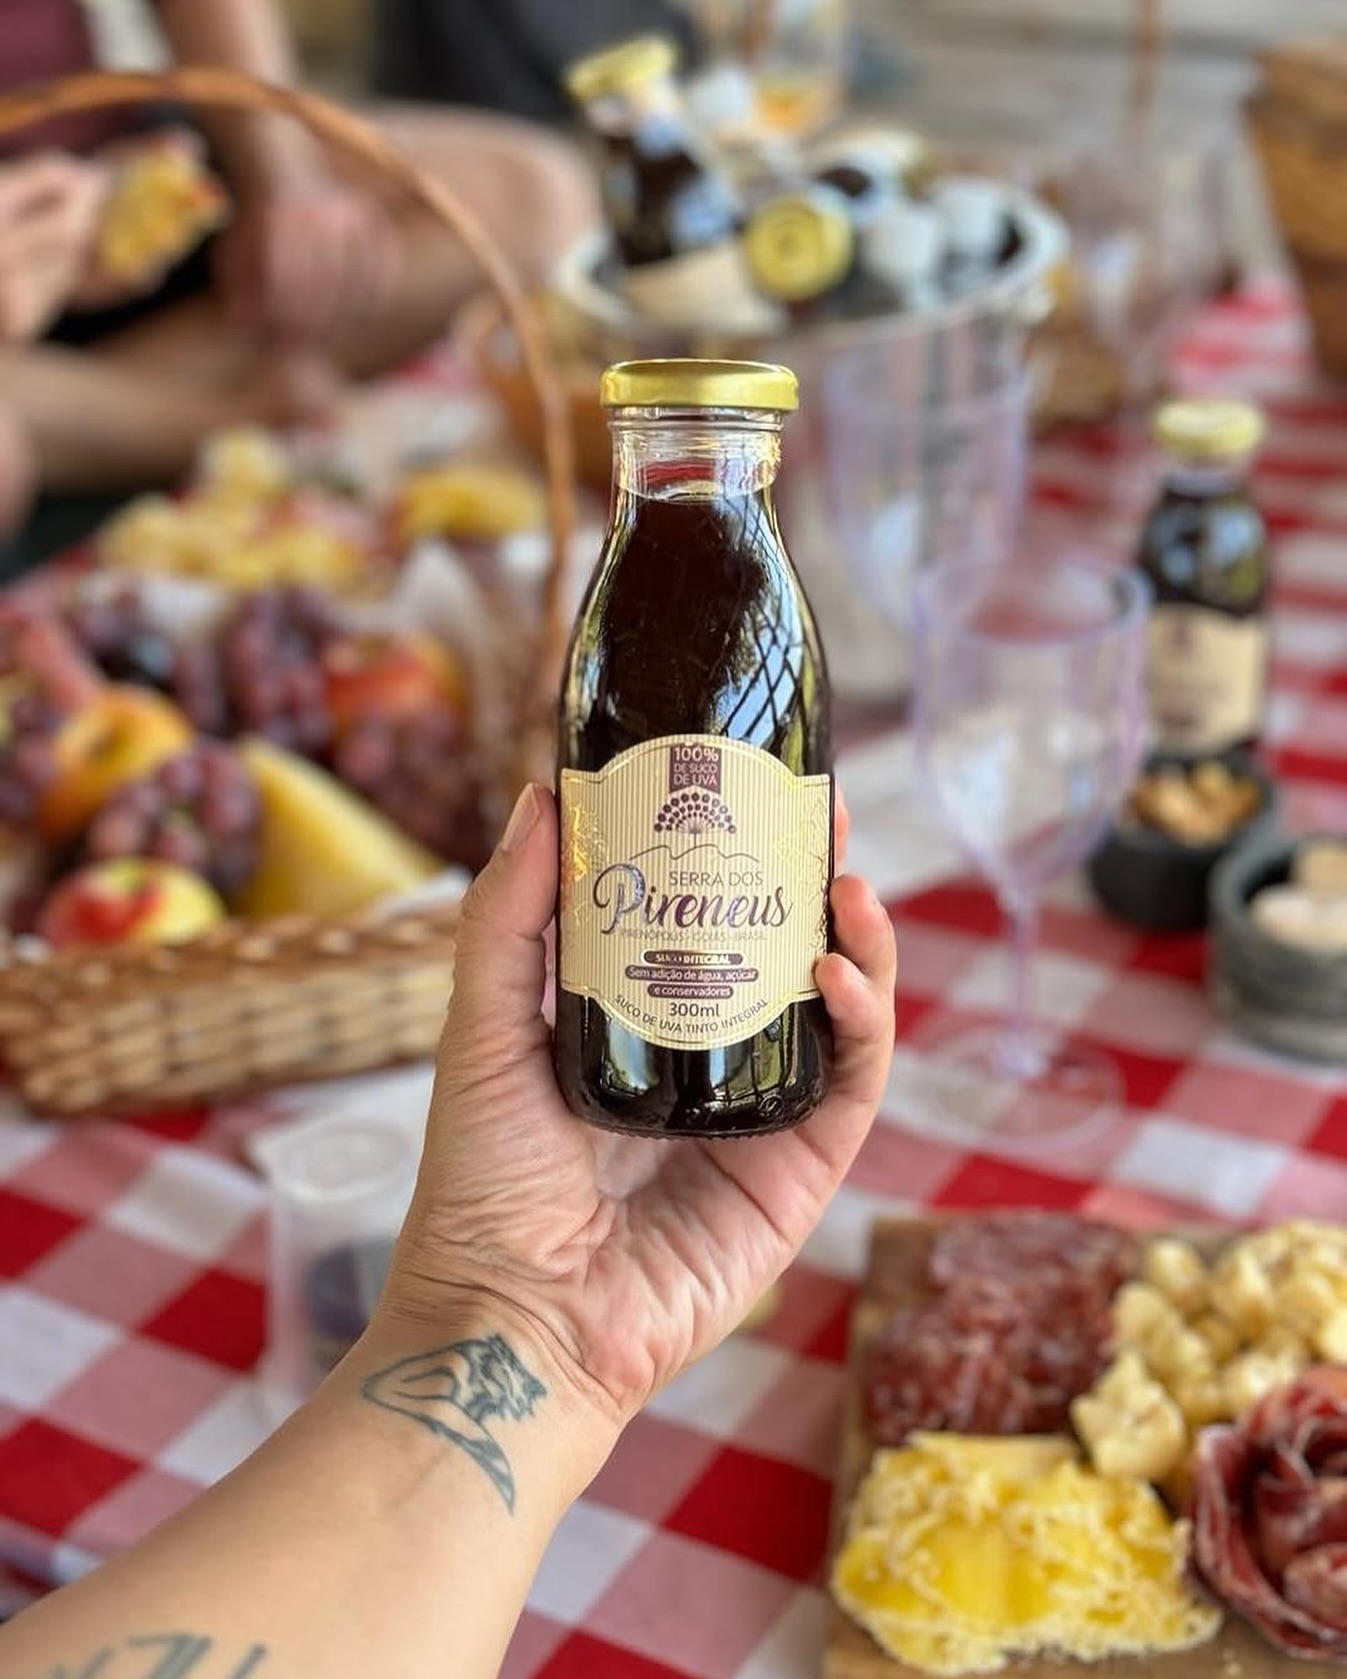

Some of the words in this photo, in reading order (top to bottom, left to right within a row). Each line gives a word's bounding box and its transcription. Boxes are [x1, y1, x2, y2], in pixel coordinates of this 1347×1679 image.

[673, 747, 719, 762] 100%
[673, 763, 688, 773] DE
[689, 763, 718, 774] SUCO
[673, 774, 690, 785] DE
[692, 774, 718, 785] UVA
[669, 871, 724, 887] SERRA
[729, 872, 764, 887] DOS
[593, 863, 794, 934] Pireneus
[629, 967, 650, 978] Sem
[651, 968, 683, 982] adição
[684, 968, 697, 979] de
[725, 969, 757, 983] açúcar
[654, 986, 661, 995] e
[662, 985, 731, 997] conservadores
[615, 994, 641, 1018] SUCO
[642, 1012, 658, 1027] DE
[659, 1019, 682, 1034] UVA
[686, 1022, 719, 1034] TINTO
[721, 999, 768, 1029] INTEGRAL
[669, 1002, 720, 1017] 300ml
